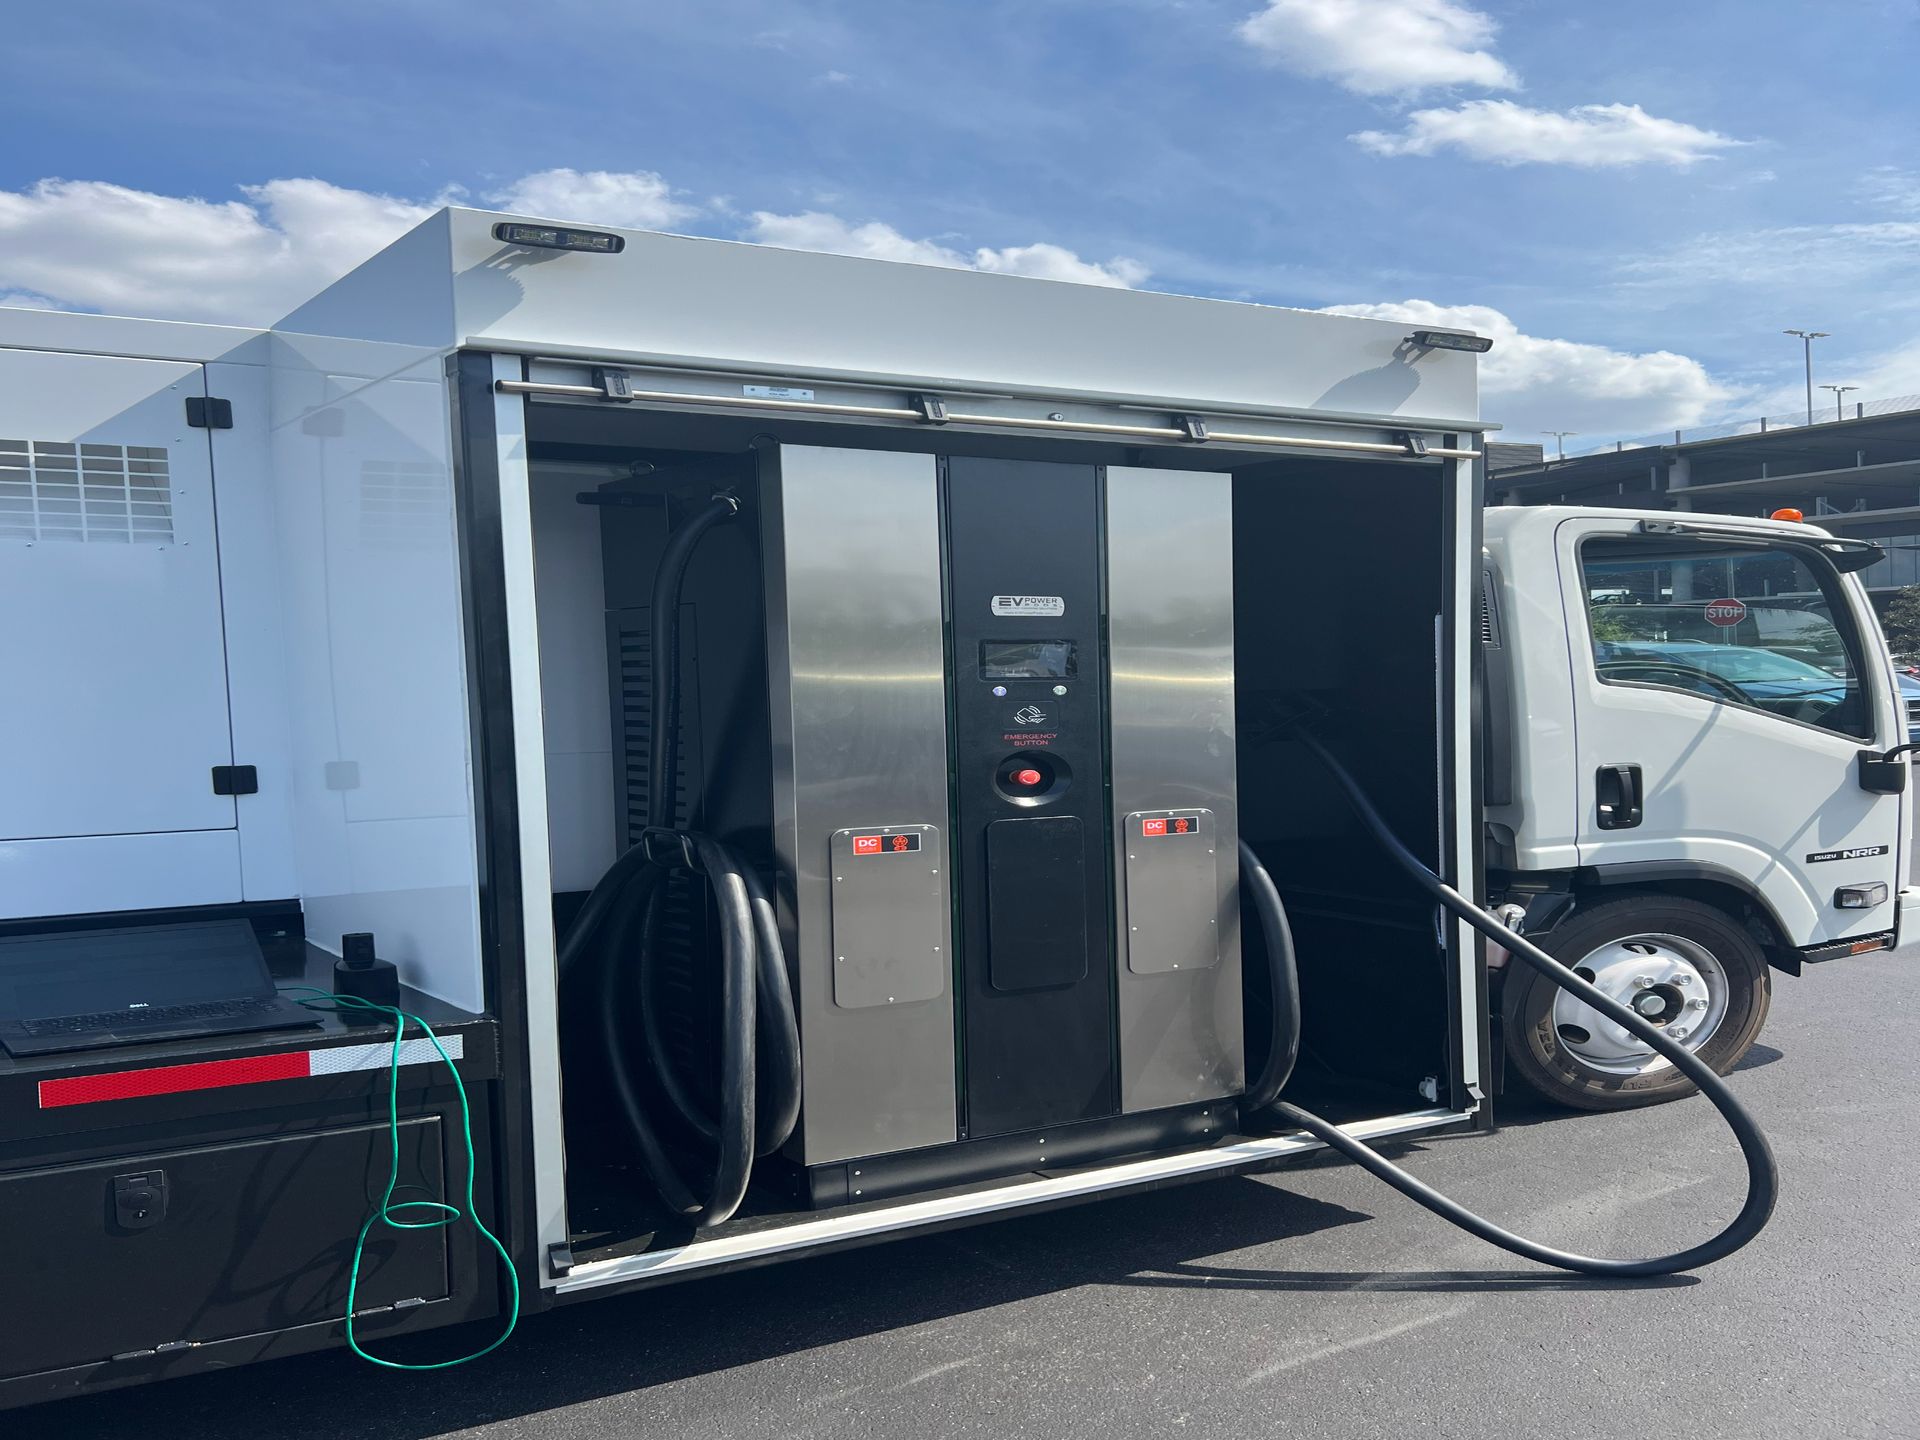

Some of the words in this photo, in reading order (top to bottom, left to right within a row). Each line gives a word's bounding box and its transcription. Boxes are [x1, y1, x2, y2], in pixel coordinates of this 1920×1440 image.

[999, 597, 1024, 607] EV
[1708, 608, 1742, 618] STOP
[858, 839, 877, 847] DC
[1814, 853, 1837, 861] ISUZU
[1843, 847, 1880, 859] NRR
